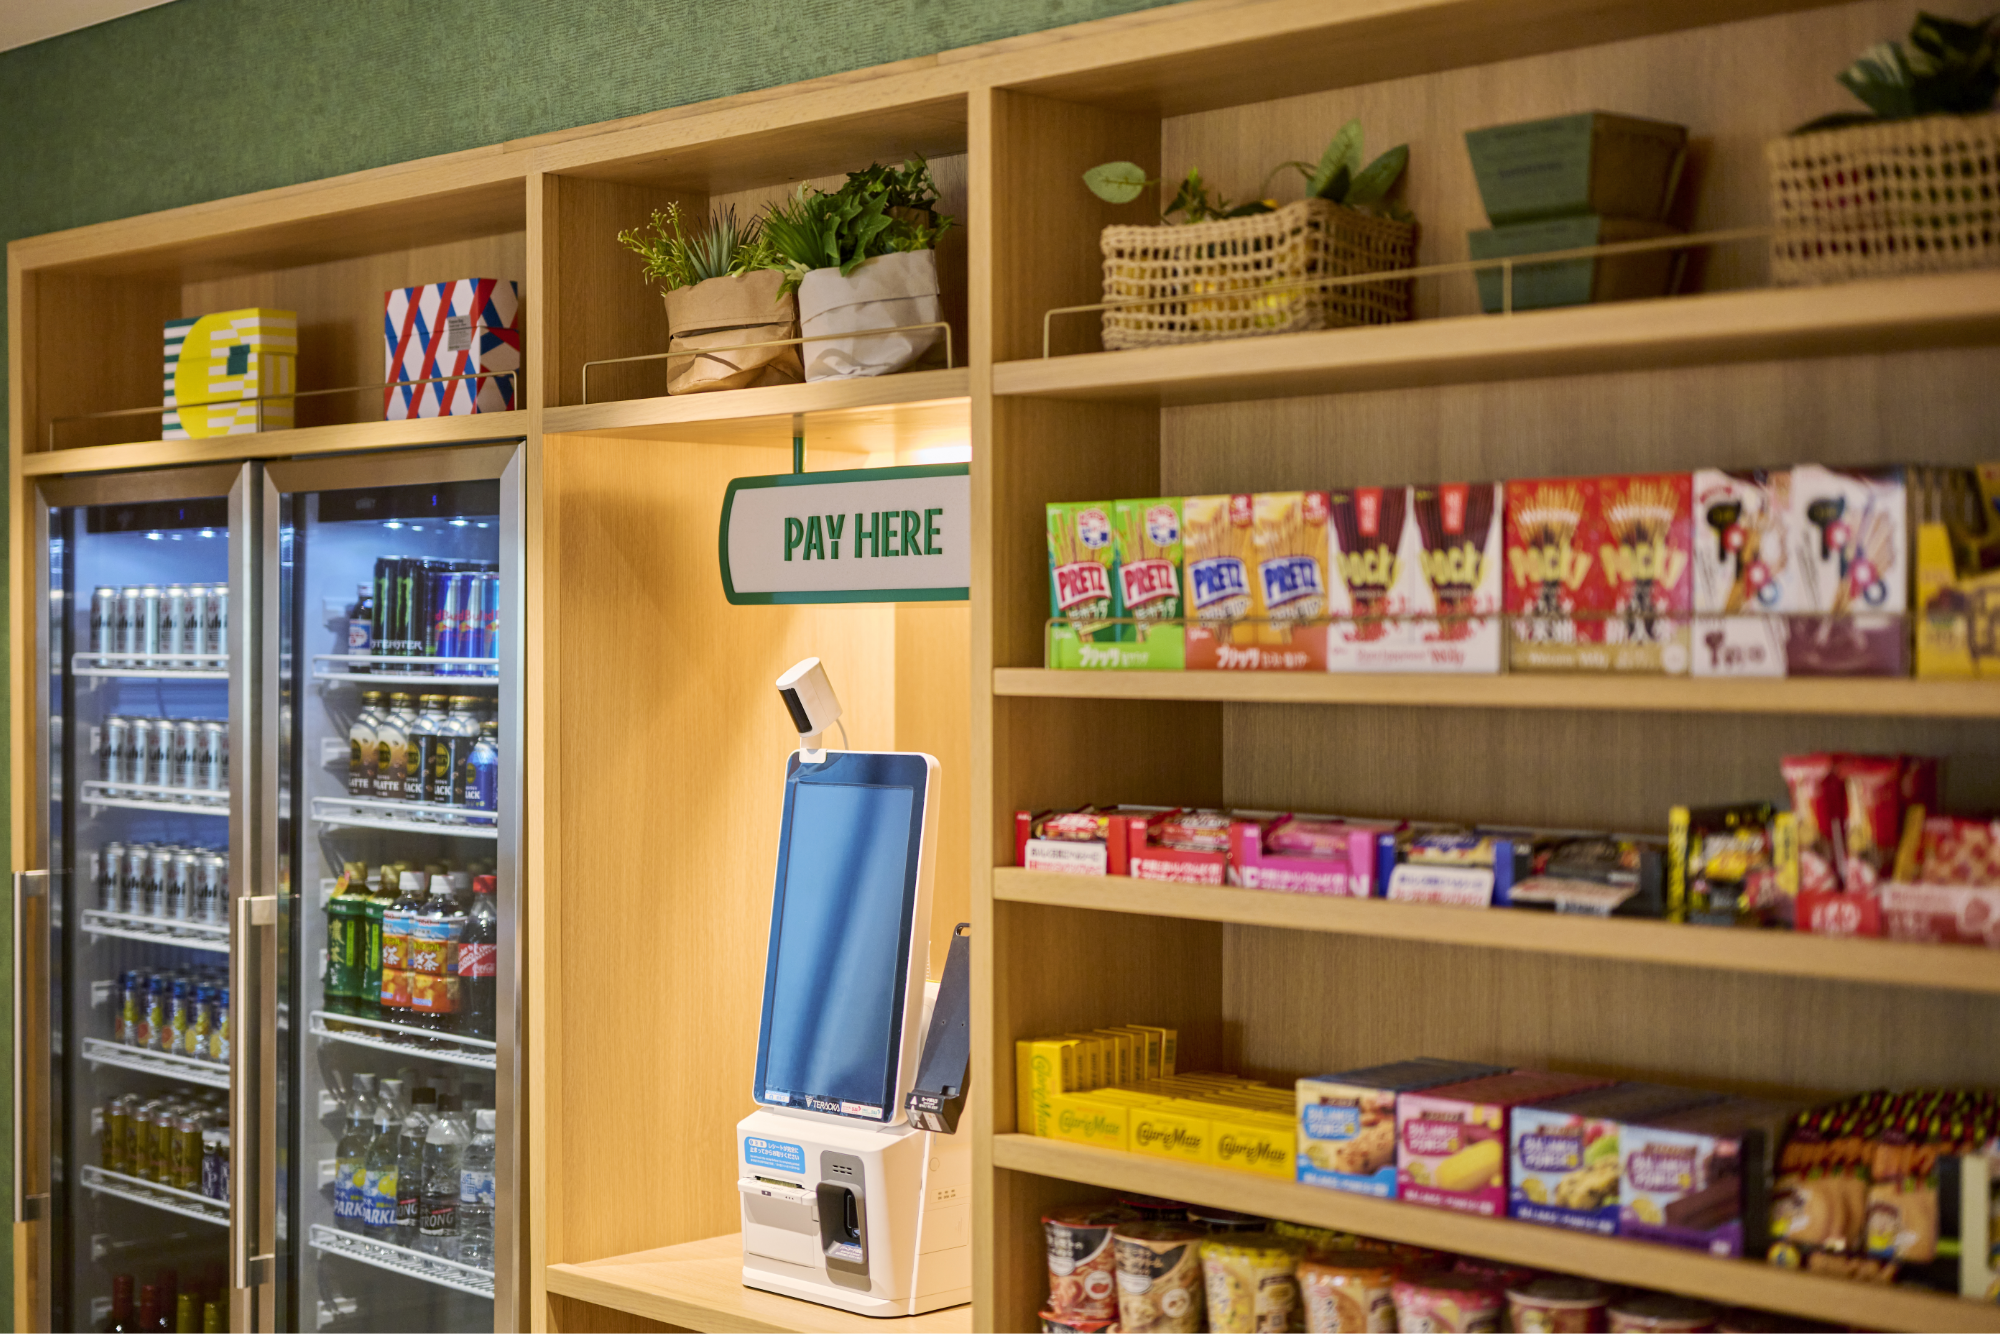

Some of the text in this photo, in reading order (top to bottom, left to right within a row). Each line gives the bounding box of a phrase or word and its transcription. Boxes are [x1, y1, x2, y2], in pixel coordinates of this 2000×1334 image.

[784, 508, 943, 562] PAY HERE
[1058, 566, 1105, 602] PRETZ
[1124, 564, 1173, 601] PRETZ
[1194, 563, 1243, 600] PRETZ
[1265, 562, 1317, 600] PRETZ
